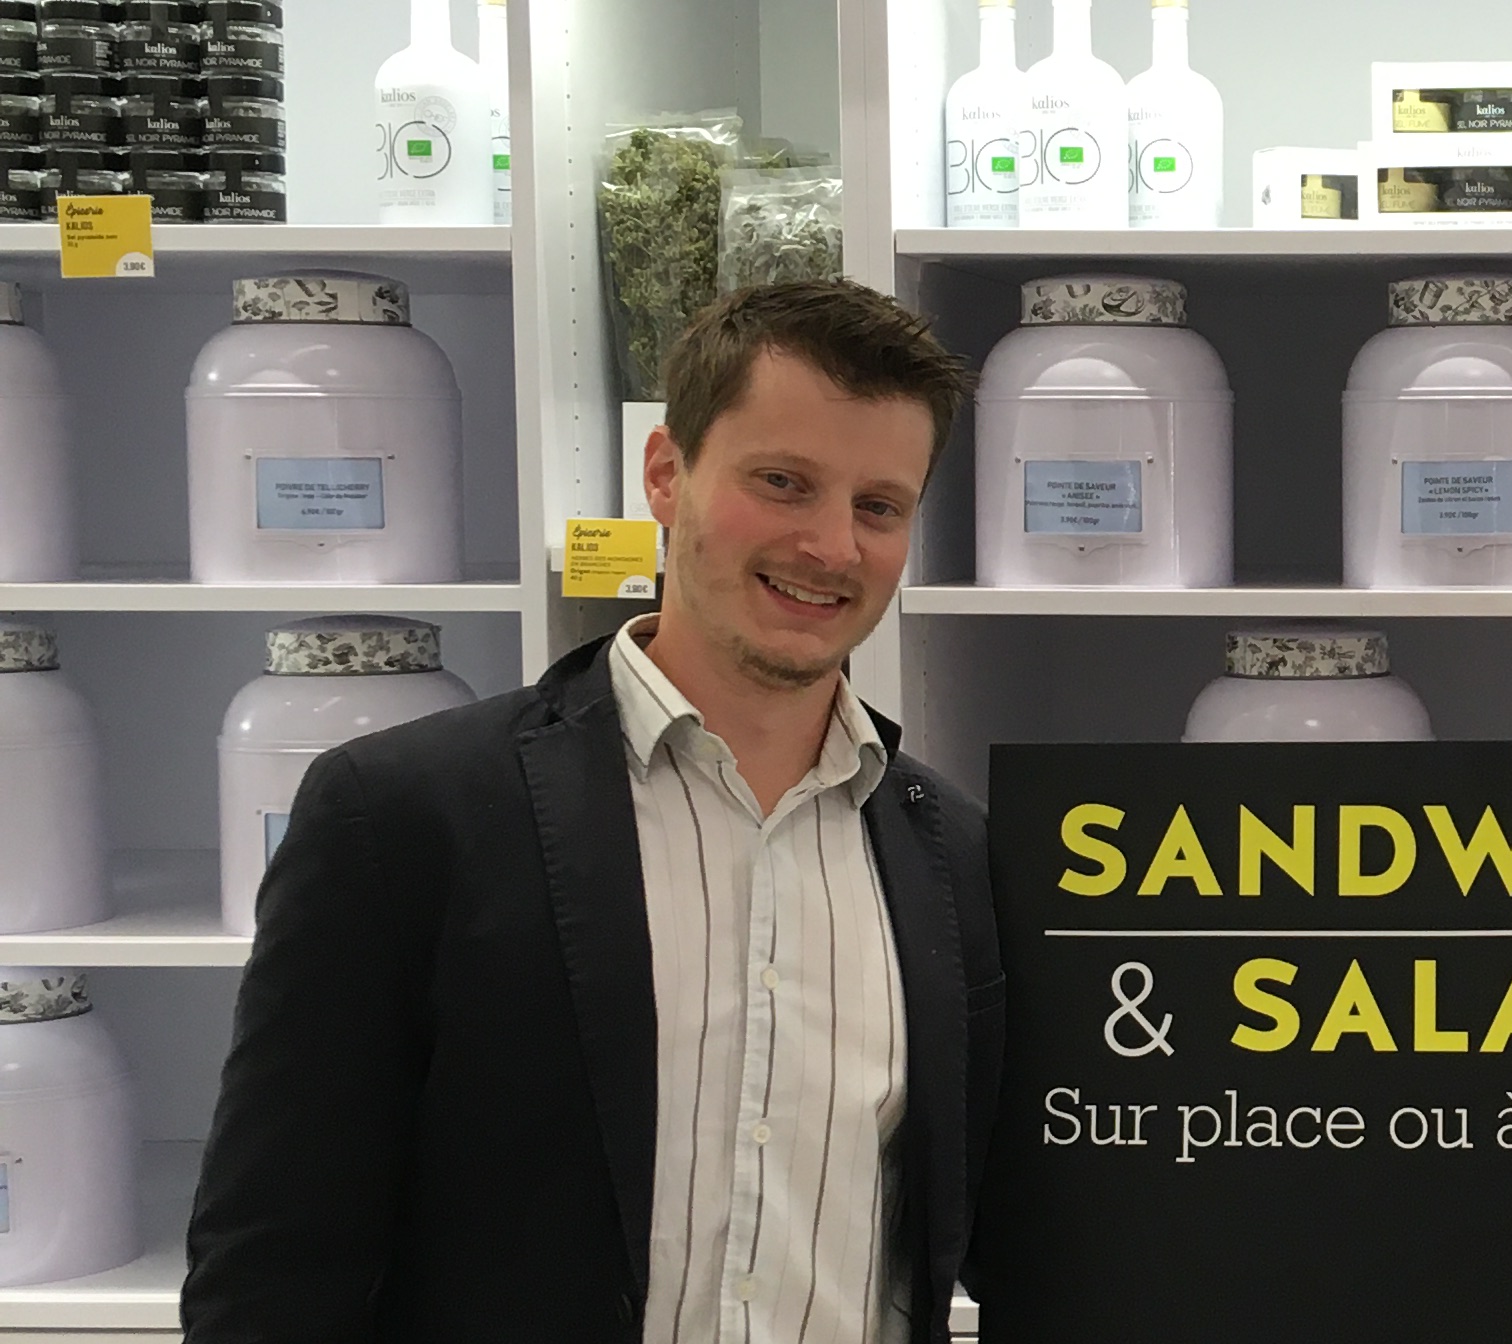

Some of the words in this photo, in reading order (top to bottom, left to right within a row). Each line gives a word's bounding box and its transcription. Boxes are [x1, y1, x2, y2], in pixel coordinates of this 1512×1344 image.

[145, 43, 177, 54] kalios
[207, 41, 235, 52] kalios
[219, 57, 263, 68] PYRAMIDE
[380, 88, 417, 103] kalios
[1032, 95, 1070, 110] kalios
[962, 107, 1001, 120] kalios
[1476, 104, 1506, 115] kalios
[50, 115, 80, 126] kalios
[147, 118, 180, 129] kalios
[1468, 120, 1487, 129] NOIR
[1465, 182, 1495, 193] kalios
[219, 192, 251, 203] kalios
[1457, 198, 1477, 206] NOIR
[1451, 476, 1461, 484] DE
[1462, 476, 1494, 484] SAVEUR
[1104, 961, 1175, 1056] &
[1043, 1087, 1158, 1148] Sur
[1175, 1088, 1366, 1163] place
[1389, 1106, 1475, 1149] ou
